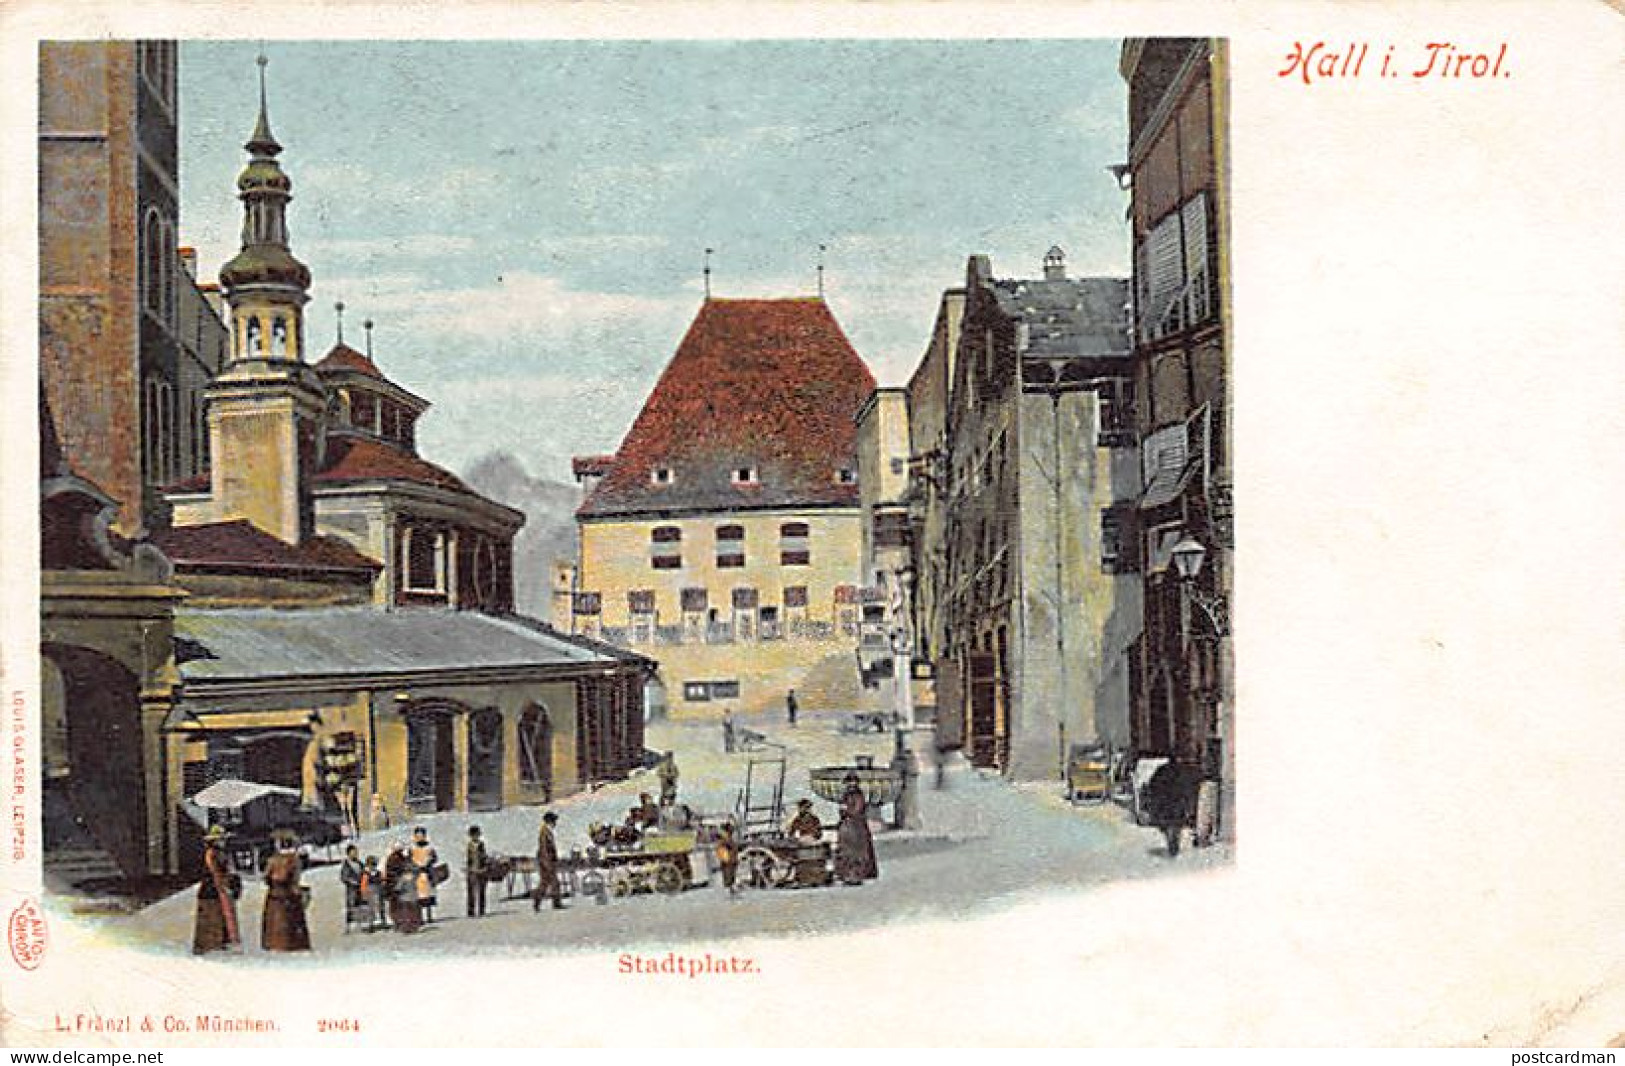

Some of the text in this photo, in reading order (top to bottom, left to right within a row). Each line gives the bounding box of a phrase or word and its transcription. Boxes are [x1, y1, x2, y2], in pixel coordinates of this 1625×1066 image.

[1277, 41, 1511, 84] Hall i. Tirol.
[12, 690, 25, 733] LOUIS
[618, 952, 762, 979] Stadtplatz.
[55, 1014, 71, 1033] L.
[140, 1014, 154, 1033] &
[164, 1014, 191, 1033] Co.
[196, 1014, 281, 1033] München.
